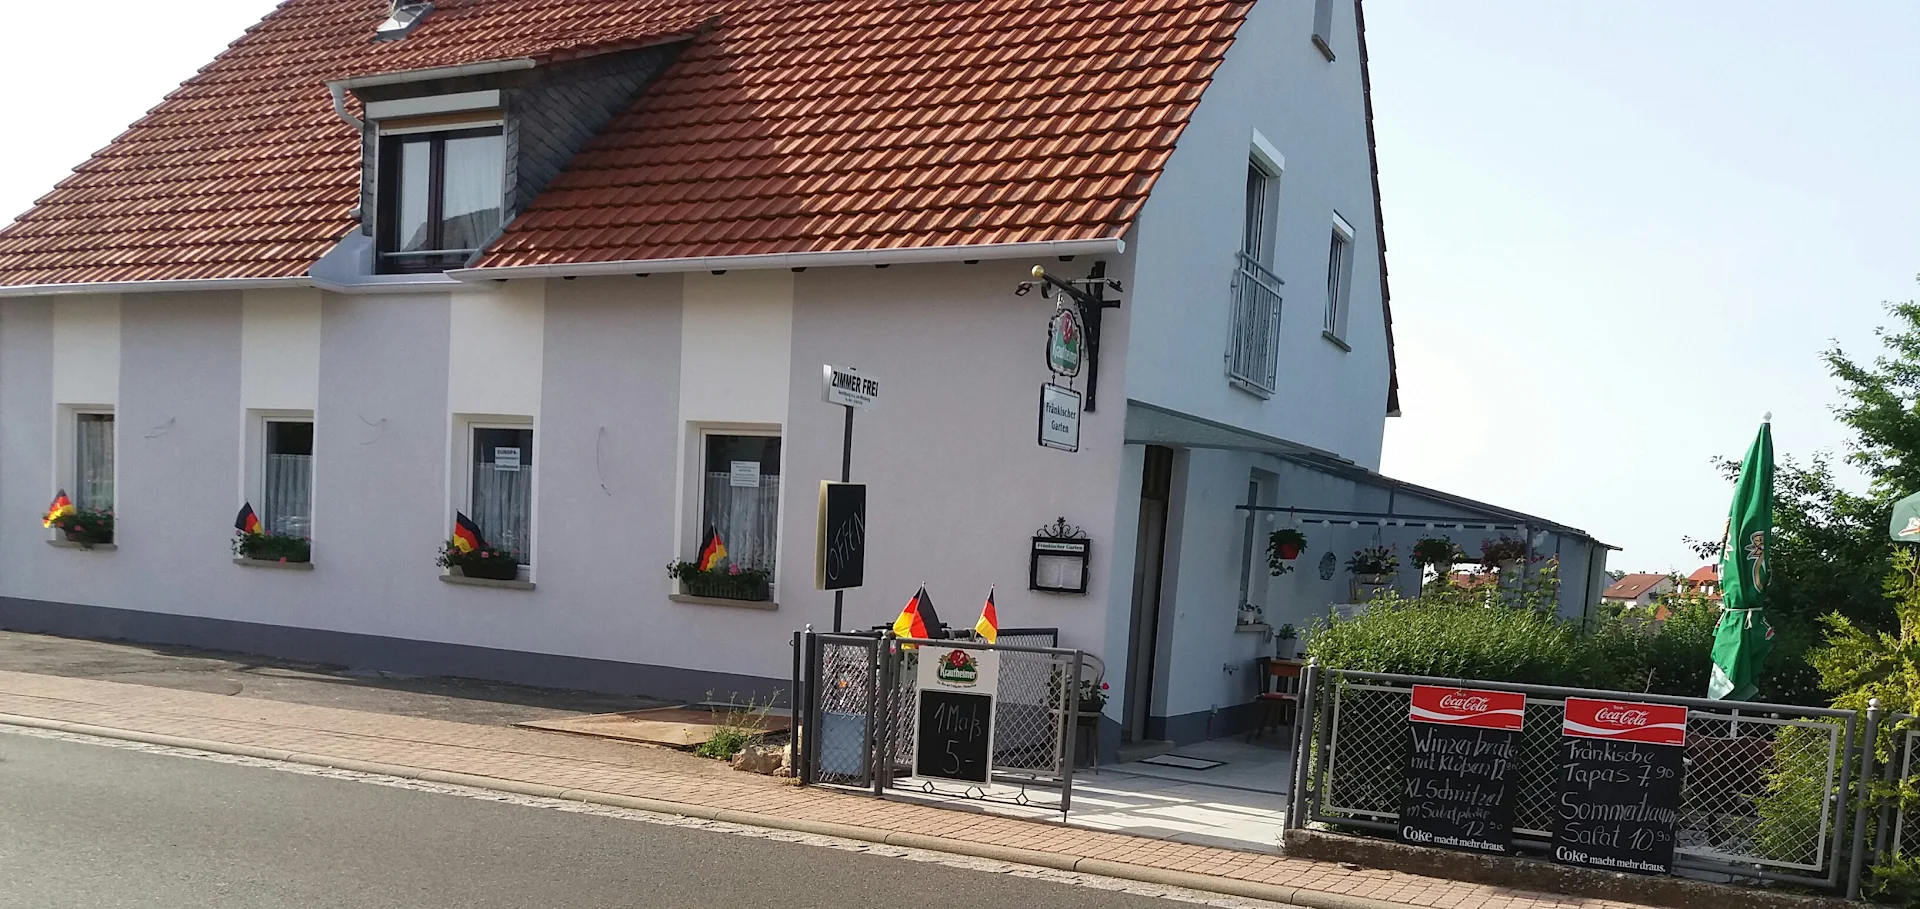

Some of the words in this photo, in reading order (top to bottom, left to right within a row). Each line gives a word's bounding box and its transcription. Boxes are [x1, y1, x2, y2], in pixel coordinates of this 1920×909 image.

[832, 370, 861, 394] ZIMMER
[862, 378, 879, 398] FREI
[1046, 402, 1076, 419] Fränkischer
[1051, 420, 1069, 433] Garten
[940, 665, 976, 680] Krautheimer
[1411, 752, 1435, 770] mit
[1404, 777, 1423, 798] XL
[1563, 762, 1631, 791] Tapas
[1403, 825, 1433, 843] Coke
[1433, 835, 1459, 847] macht
[1459, 838, 1482, 849] mehr
[1560, 822, 1620, 848] Salat
[1556, 845, 1588, 864] Coke
[1589, 856, 1617, 867] macht
[1616, 859, 1641, 870] mehr
